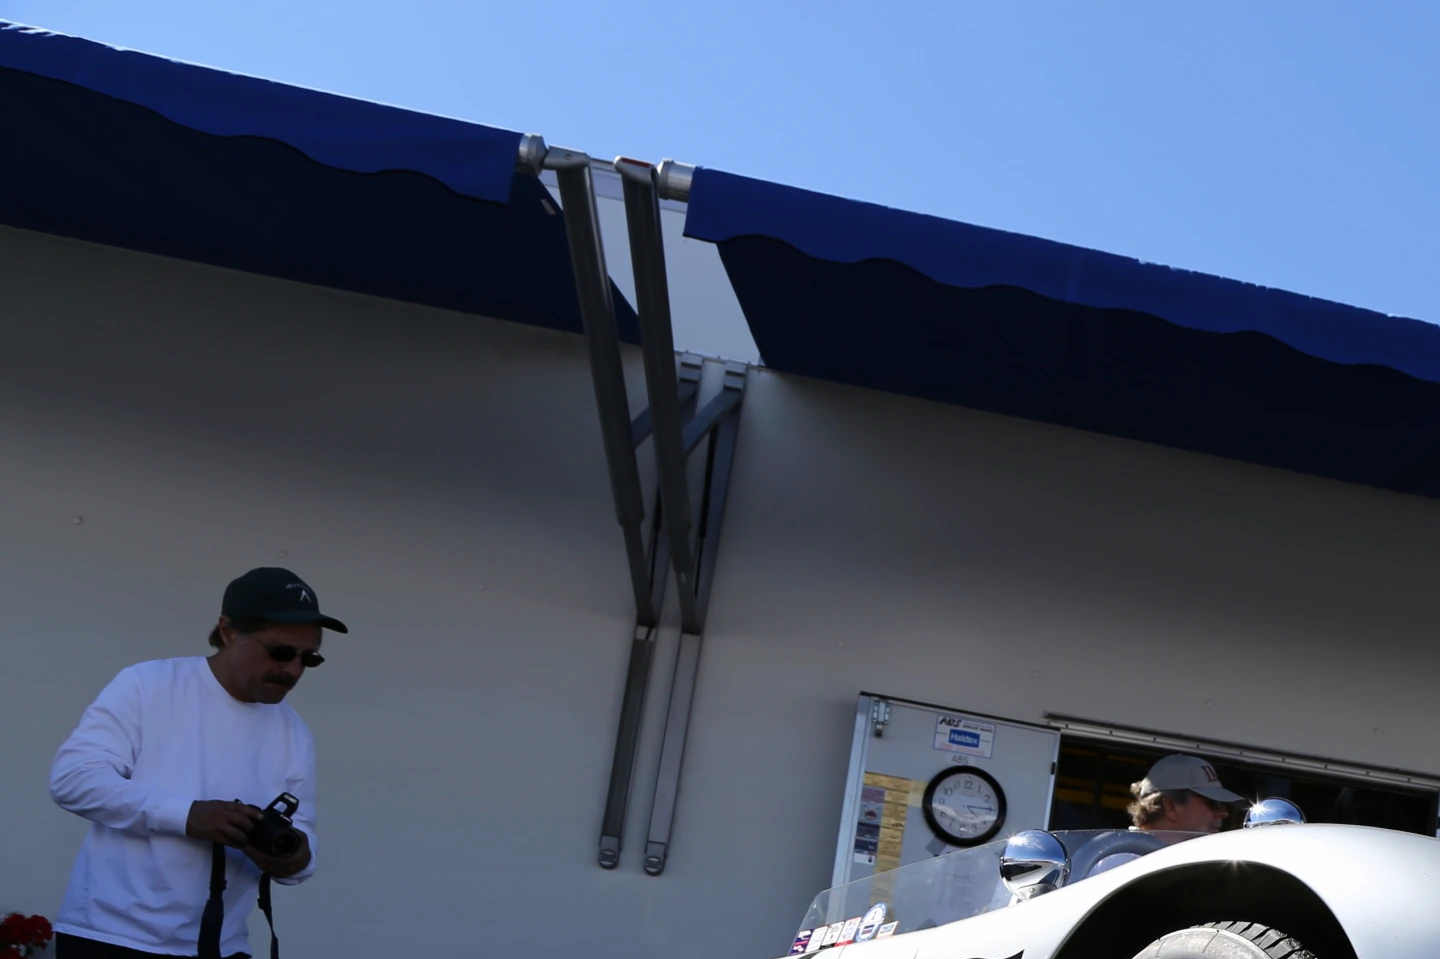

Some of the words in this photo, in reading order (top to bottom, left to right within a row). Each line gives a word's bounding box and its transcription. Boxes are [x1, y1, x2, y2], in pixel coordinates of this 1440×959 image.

[938, 717, 962, 728] ABS
[950, 732, 978, 745] Haldex
[951, 754, 969, 765] ABS
[964, 780, 973, 790] 12
